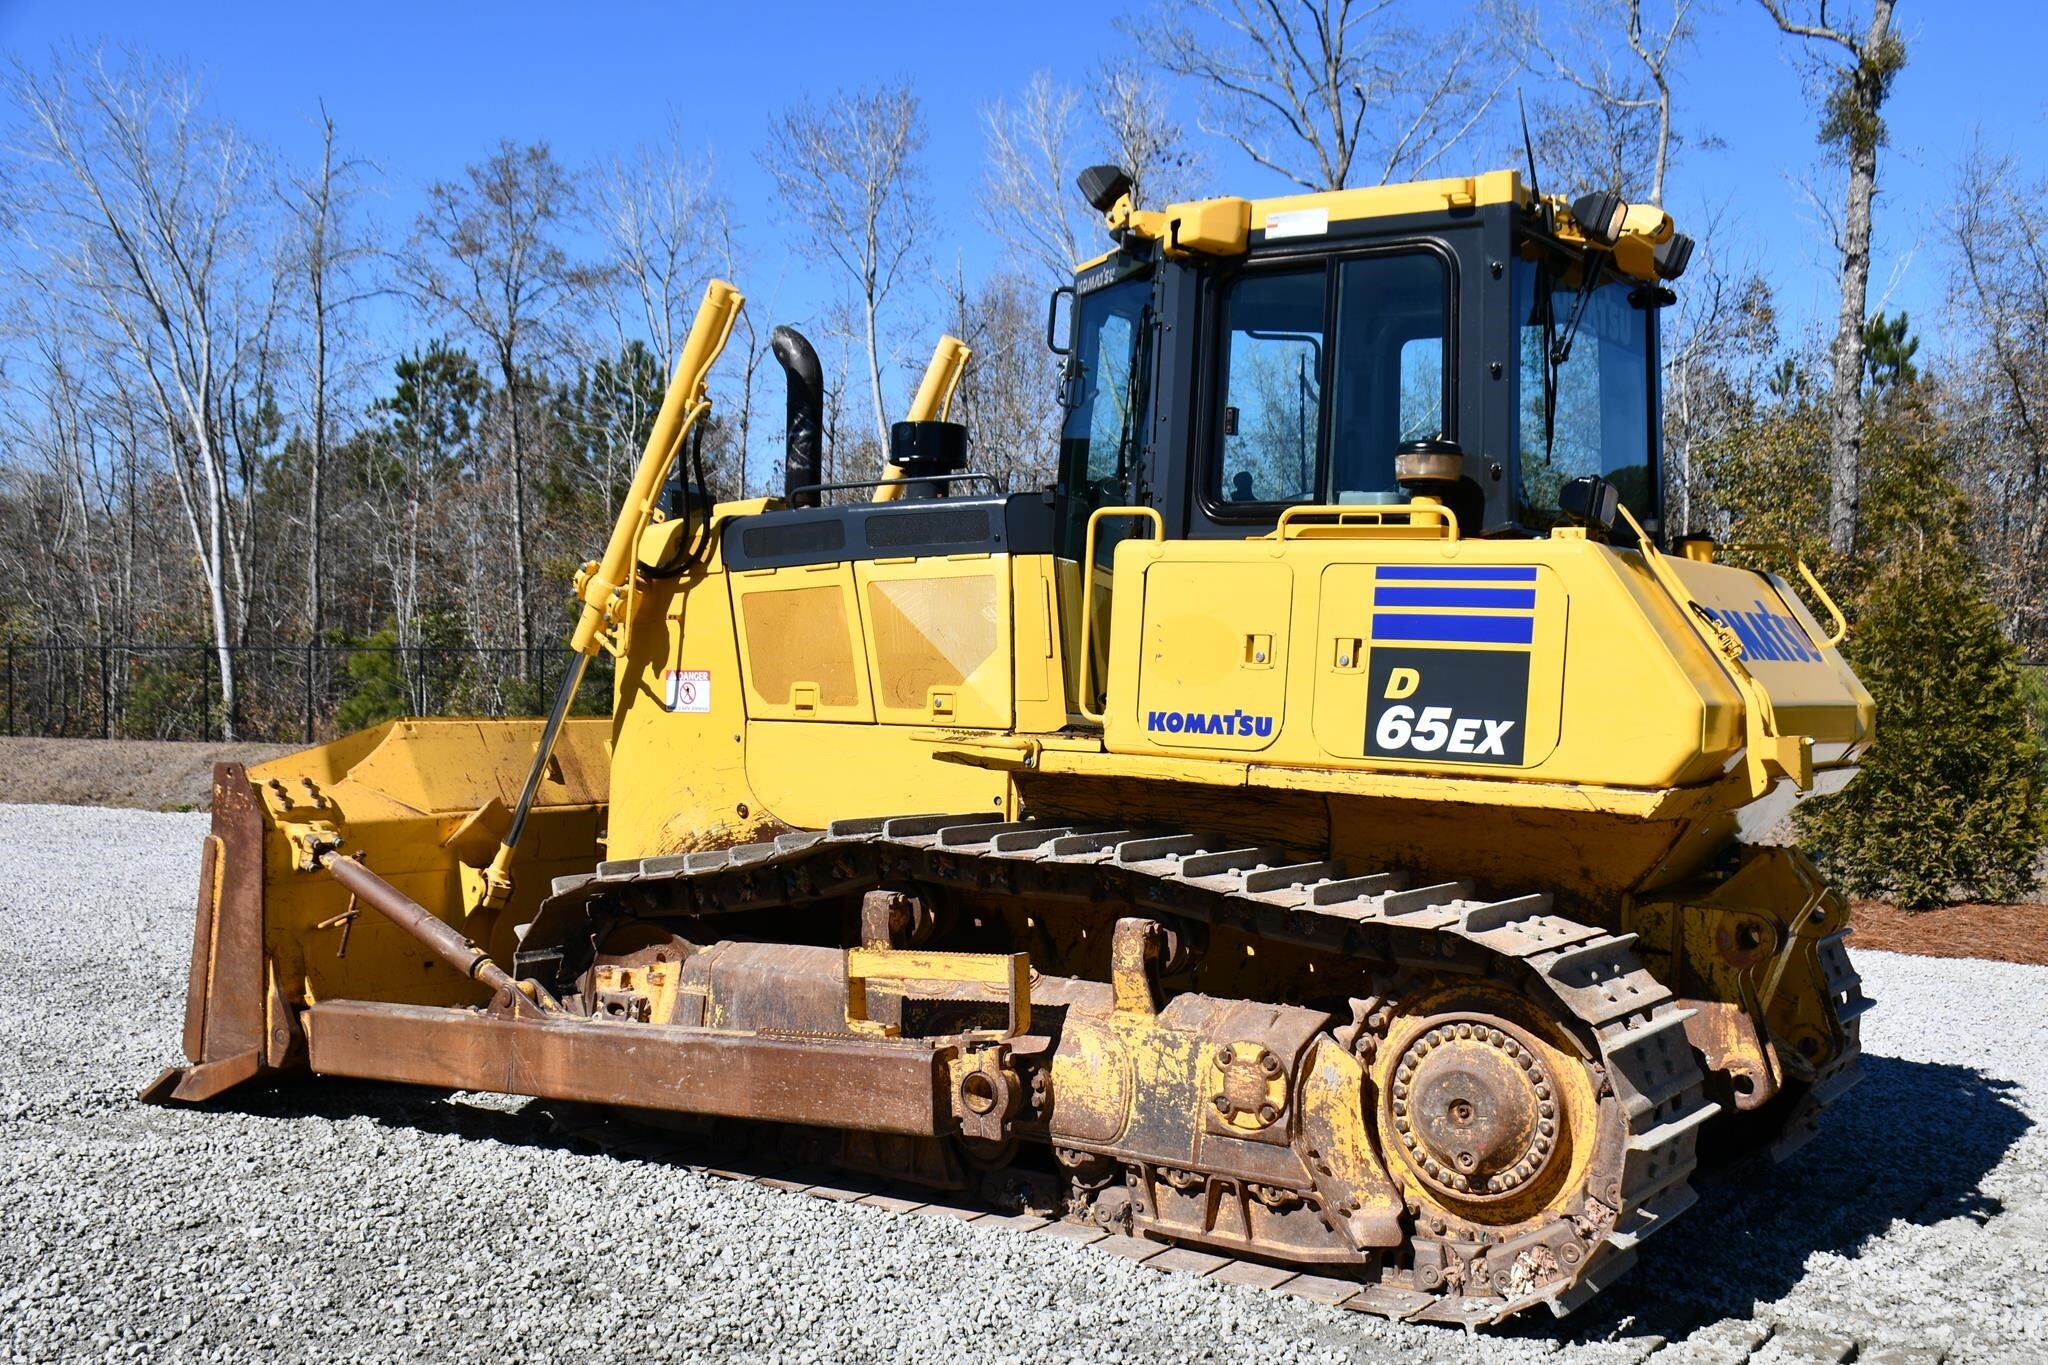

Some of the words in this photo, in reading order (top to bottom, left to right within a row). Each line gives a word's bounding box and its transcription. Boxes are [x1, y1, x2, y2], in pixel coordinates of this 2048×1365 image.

[1076, 267, 1116, 295] KOMATSU
[678, 671, 709, 681] DANGER
[1383, 667, 1420, 699] D
[1147, 708, 1273, 737] KOMATSU
[1375, 705, 1515, 756] 65EX
